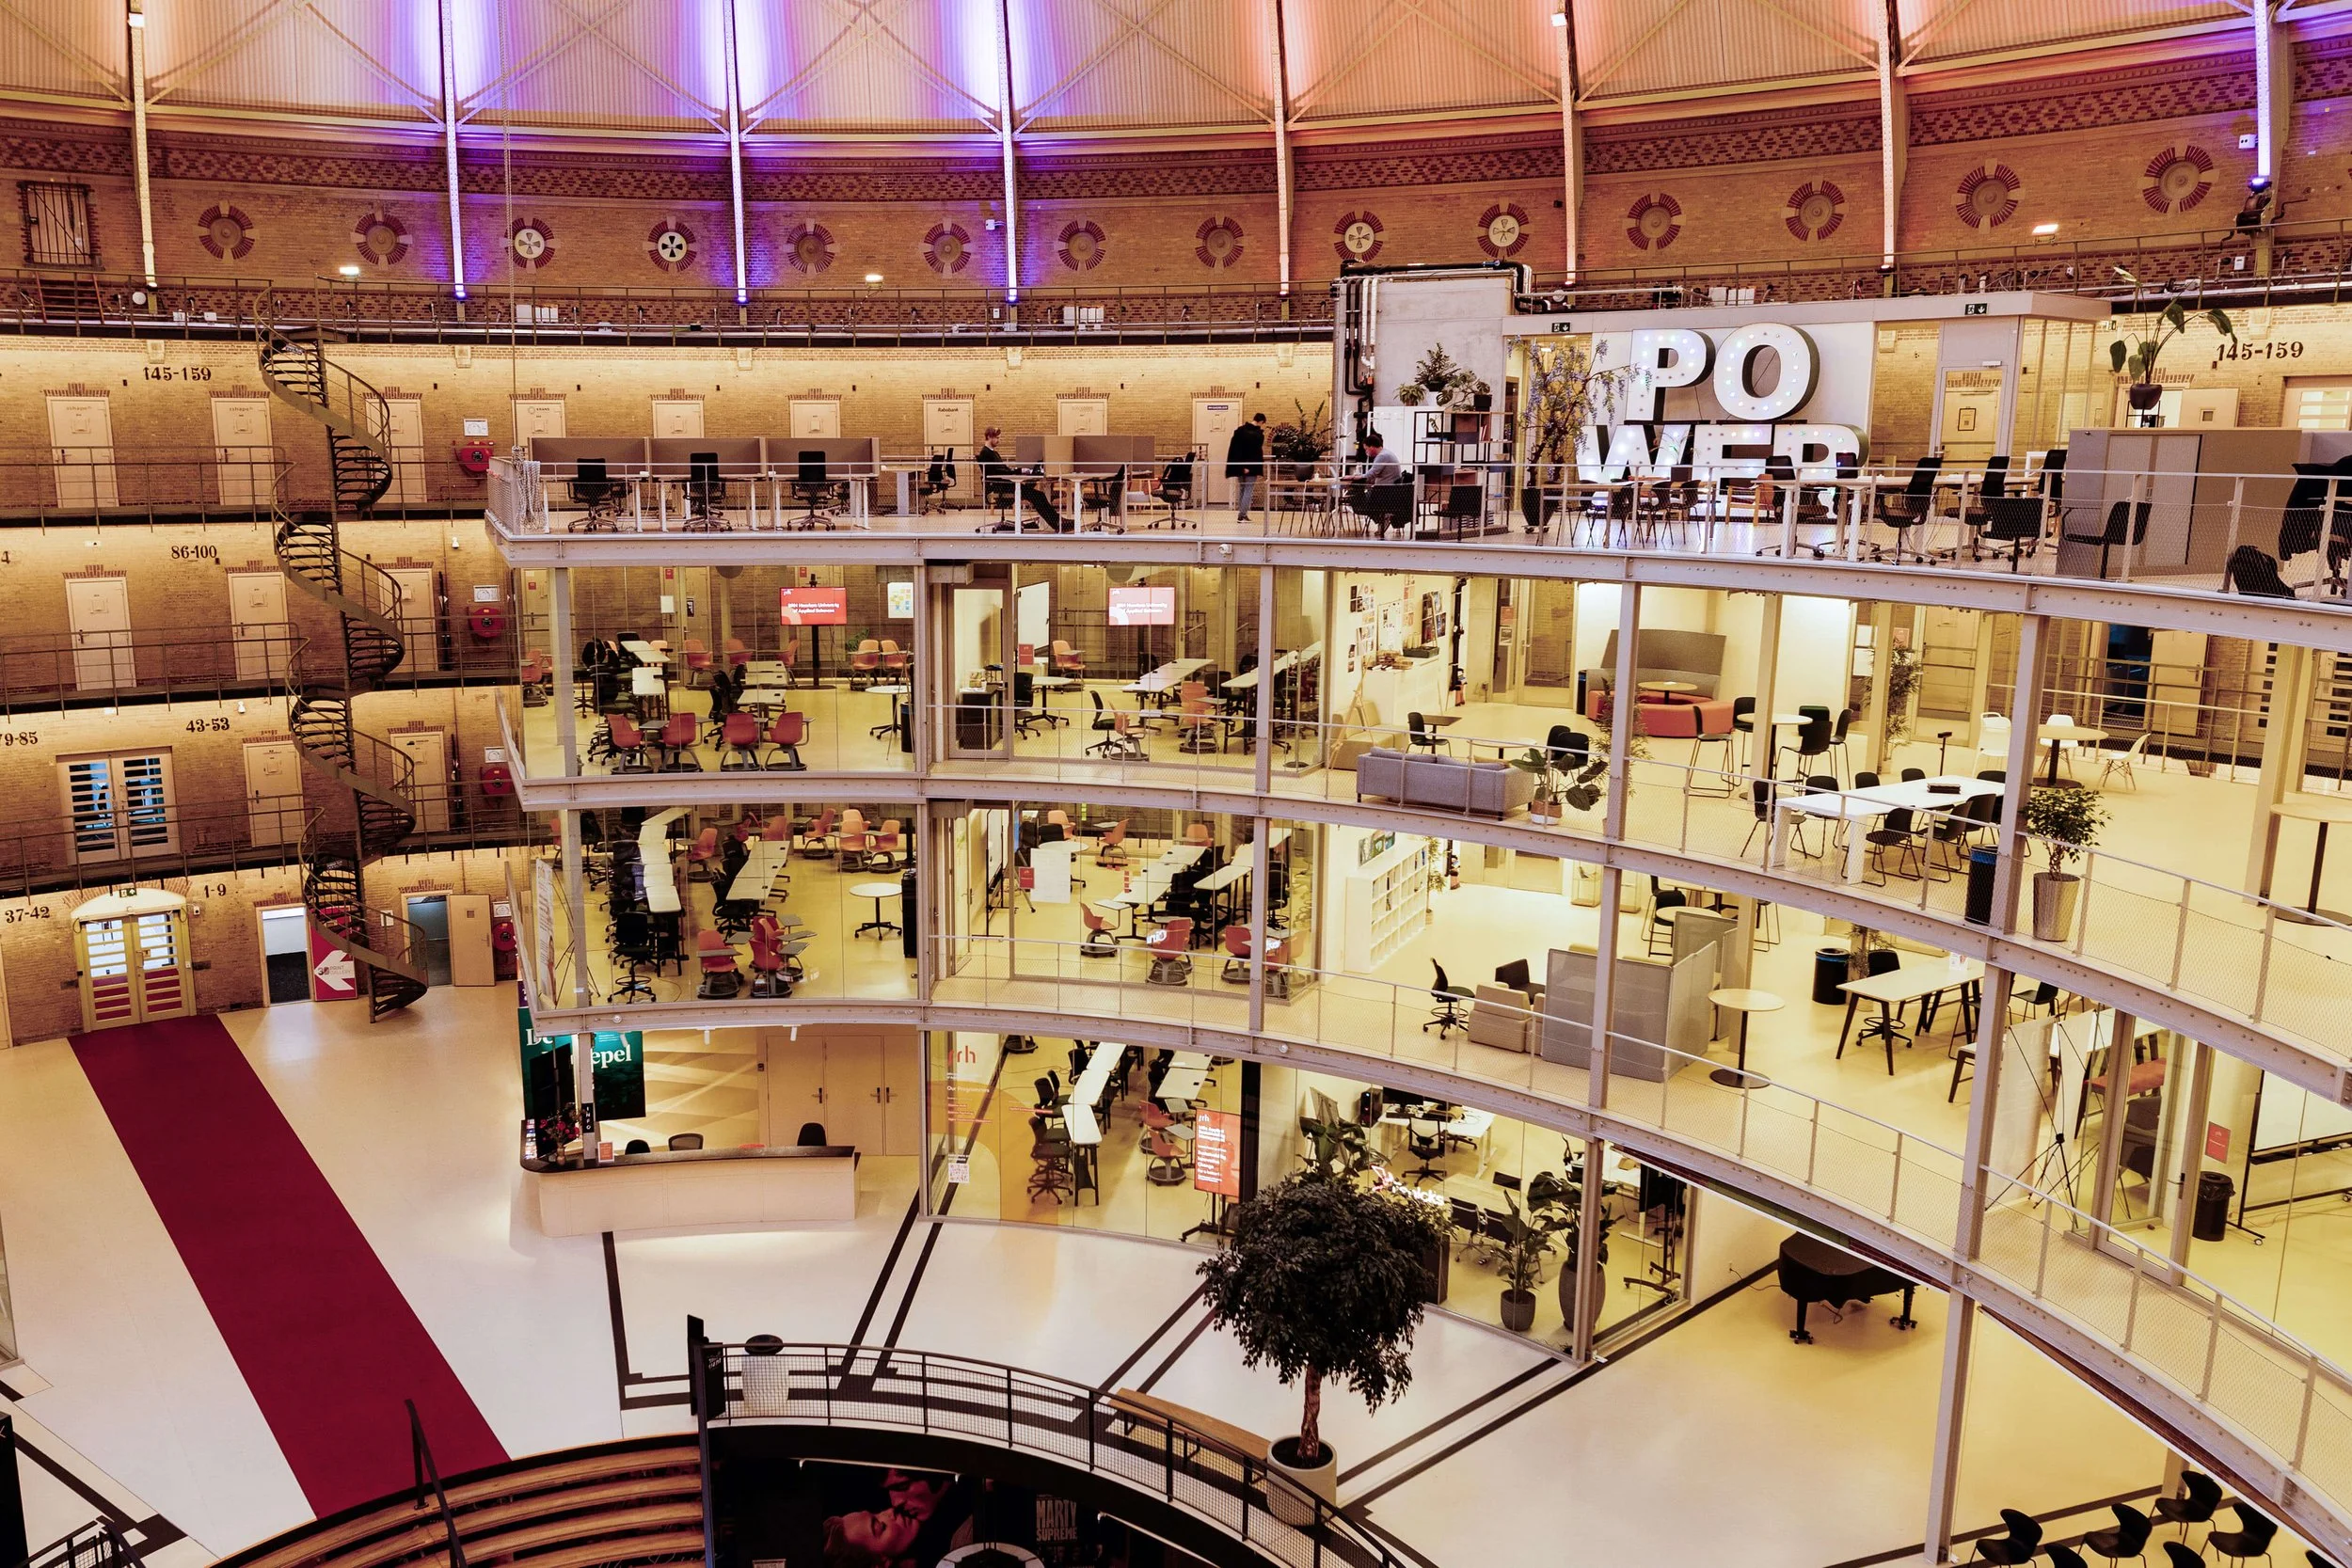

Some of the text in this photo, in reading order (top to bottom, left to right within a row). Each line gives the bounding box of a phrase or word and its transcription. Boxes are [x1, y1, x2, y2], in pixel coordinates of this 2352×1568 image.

[2217, 341, 2304, 361] 145-159
[143, 366, 212, 381] 145-159
[1626, 323, 1820, 420] PO
[171, 545, 217, 559] 86-100
[186, 717, 230, 733] 43-53
[0, 731, 39, 747] 9-85
[203, 883, 227, 898] 1-9
[5, 906, 51, 924] 37-42
[1036, 1498, 1077, 1528] MARTY
[1036, 1527, 1078, 1542] SUPREME
